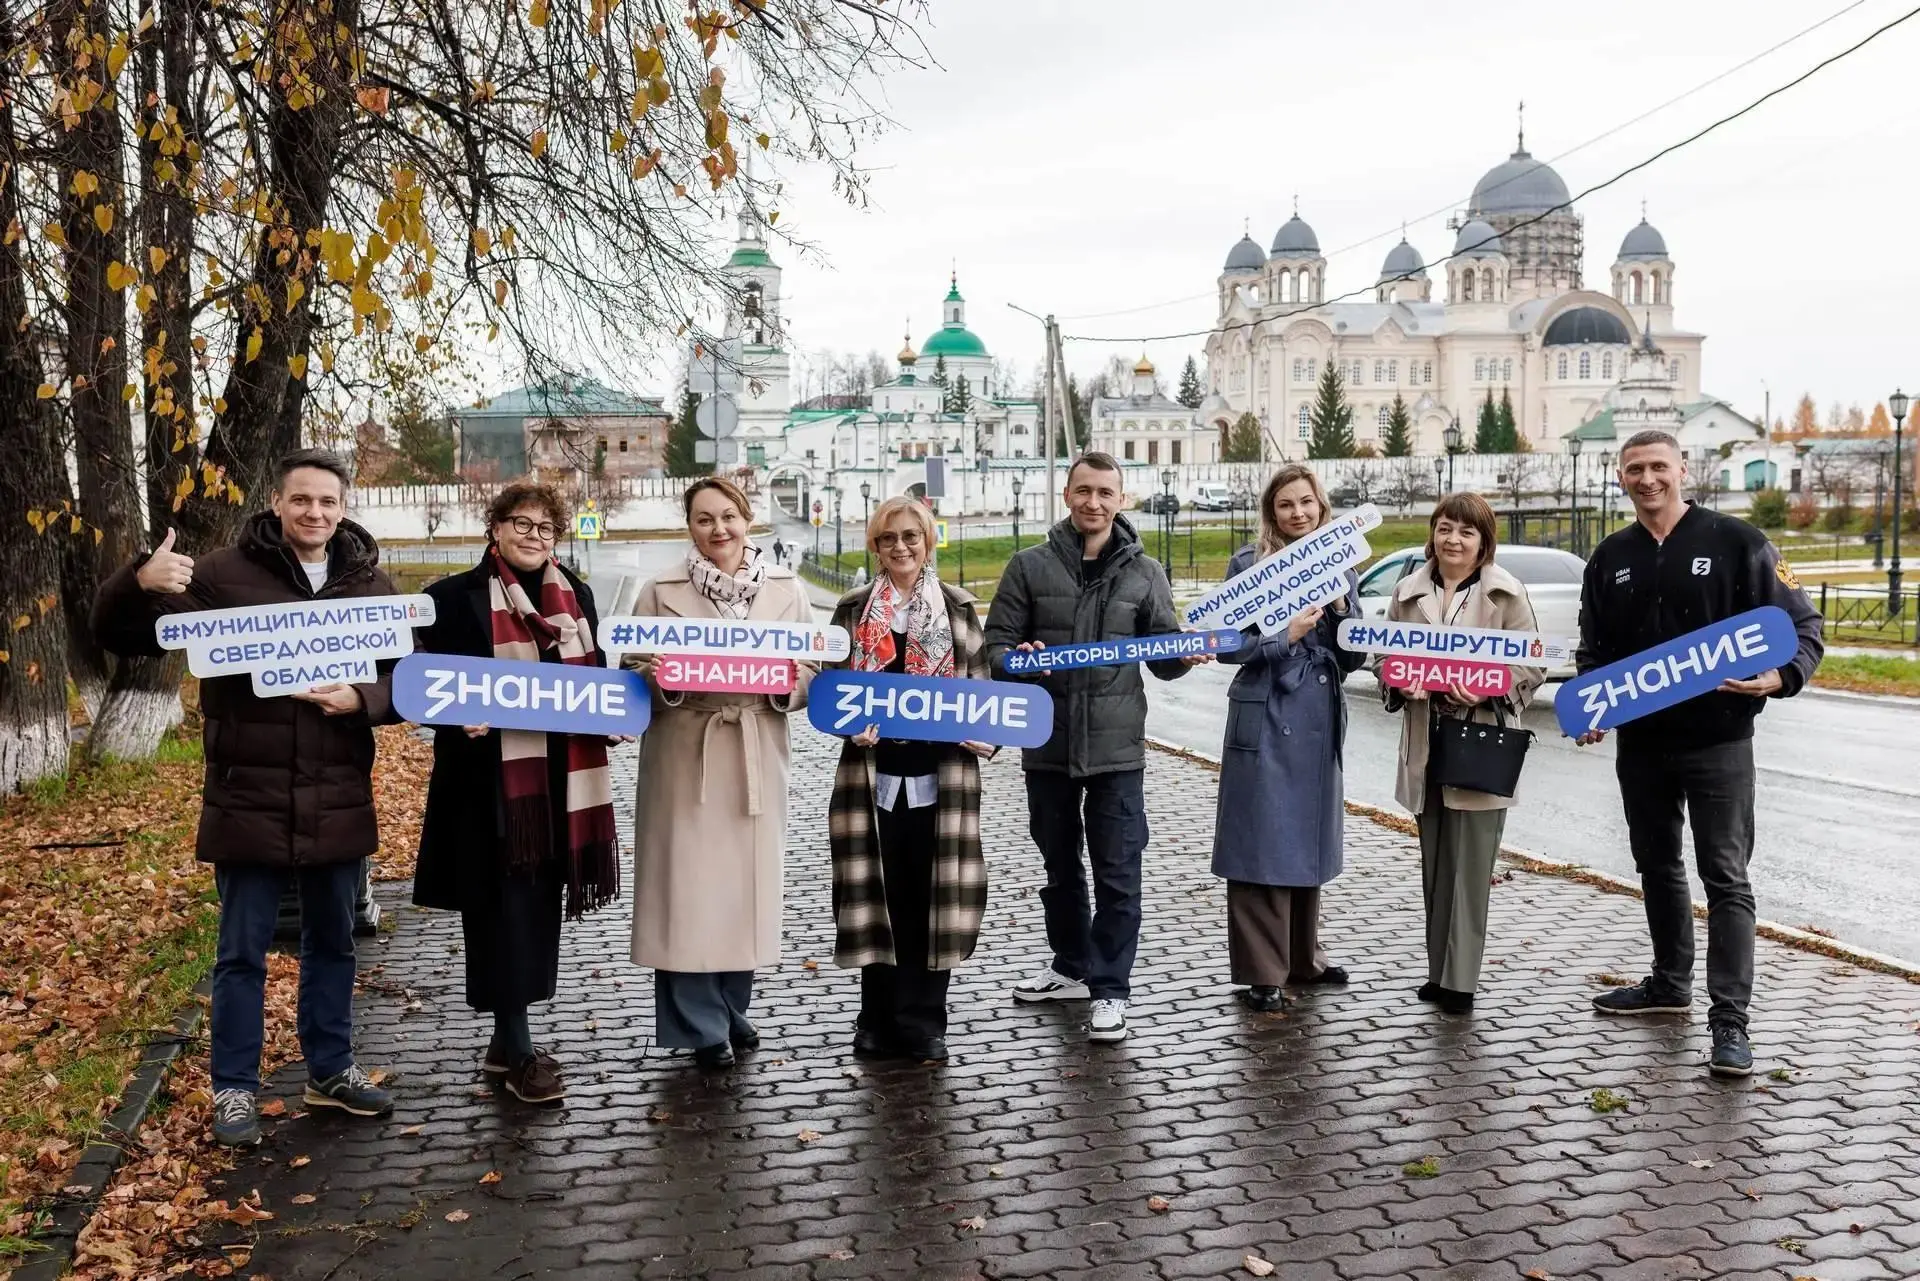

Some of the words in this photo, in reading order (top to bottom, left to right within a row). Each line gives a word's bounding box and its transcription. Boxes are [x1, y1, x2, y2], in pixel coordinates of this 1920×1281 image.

[1187, 520, 1357, 624] #МУНИЦИПАЛИТЕТЫ
[1223, 543, 1357, 626] СВЕРДЛОВСКОЙ
[1264, 576, 1342, 626] ОБЛАСТИ
[162, 604, 407, 642] #МУНИЦИПАЛИТЕТЫ
[611, 624, 810, 652] #МАРШРУТЫ
[209, 628, 397, 664] СВЕРДЛОВСКОЙ
[1009, 648, 1120, 669] #ЛЕКТОРЫ
[1126, 637, 1205, 658] ЗНАНИЯ
[1348, 626, 1528, 658] #МАРШРУТЫ
[261, 661, 369, 687] ОБЛАСТИ
[664, 660, 789, 687] ЗНАНИЯ
[1389, 661, 1504, 689] ЗНАНИЯ
